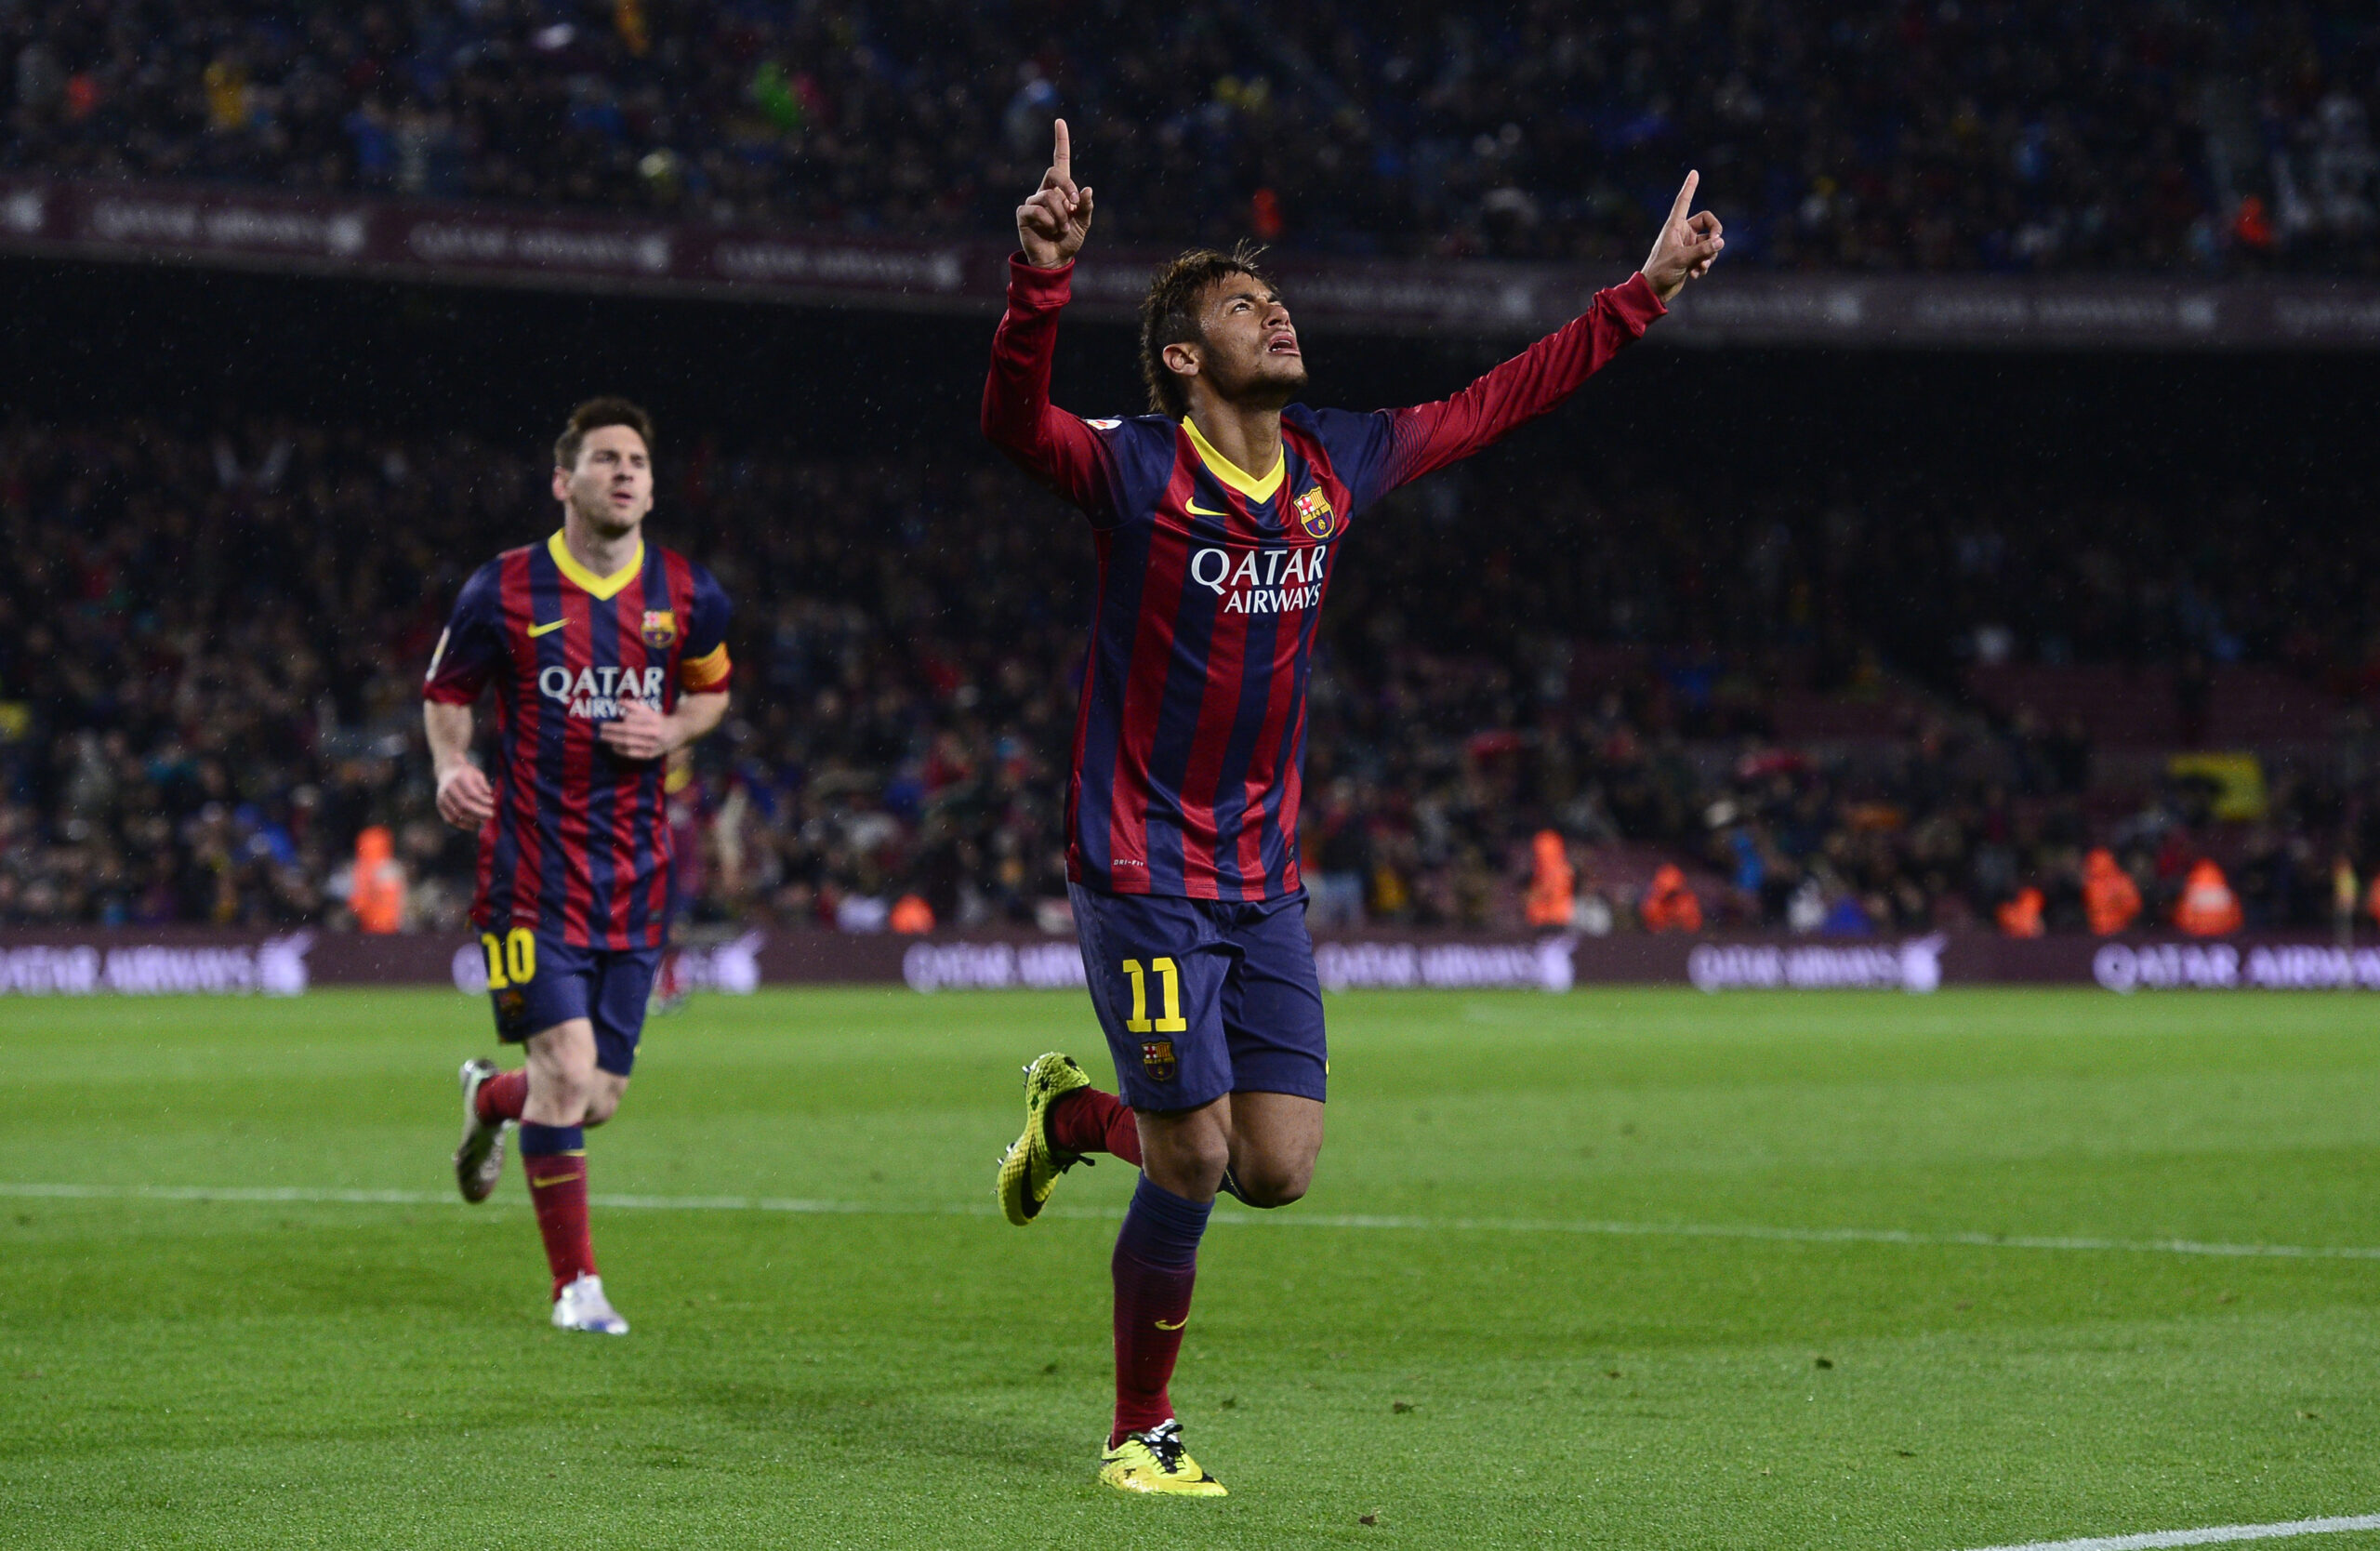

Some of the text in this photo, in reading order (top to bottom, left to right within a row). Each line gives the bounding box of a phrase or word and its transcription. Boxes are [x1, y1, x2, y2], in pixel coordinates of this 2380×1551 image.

[1191, 545, 1328, 595] QATAR
[1224, 586, 1320, 614] AIRWAYS
[539, 666, 664, 704] QATAR
[482, 927, 536, 989] 10
[1122, 957, 1186, 1033] 11
